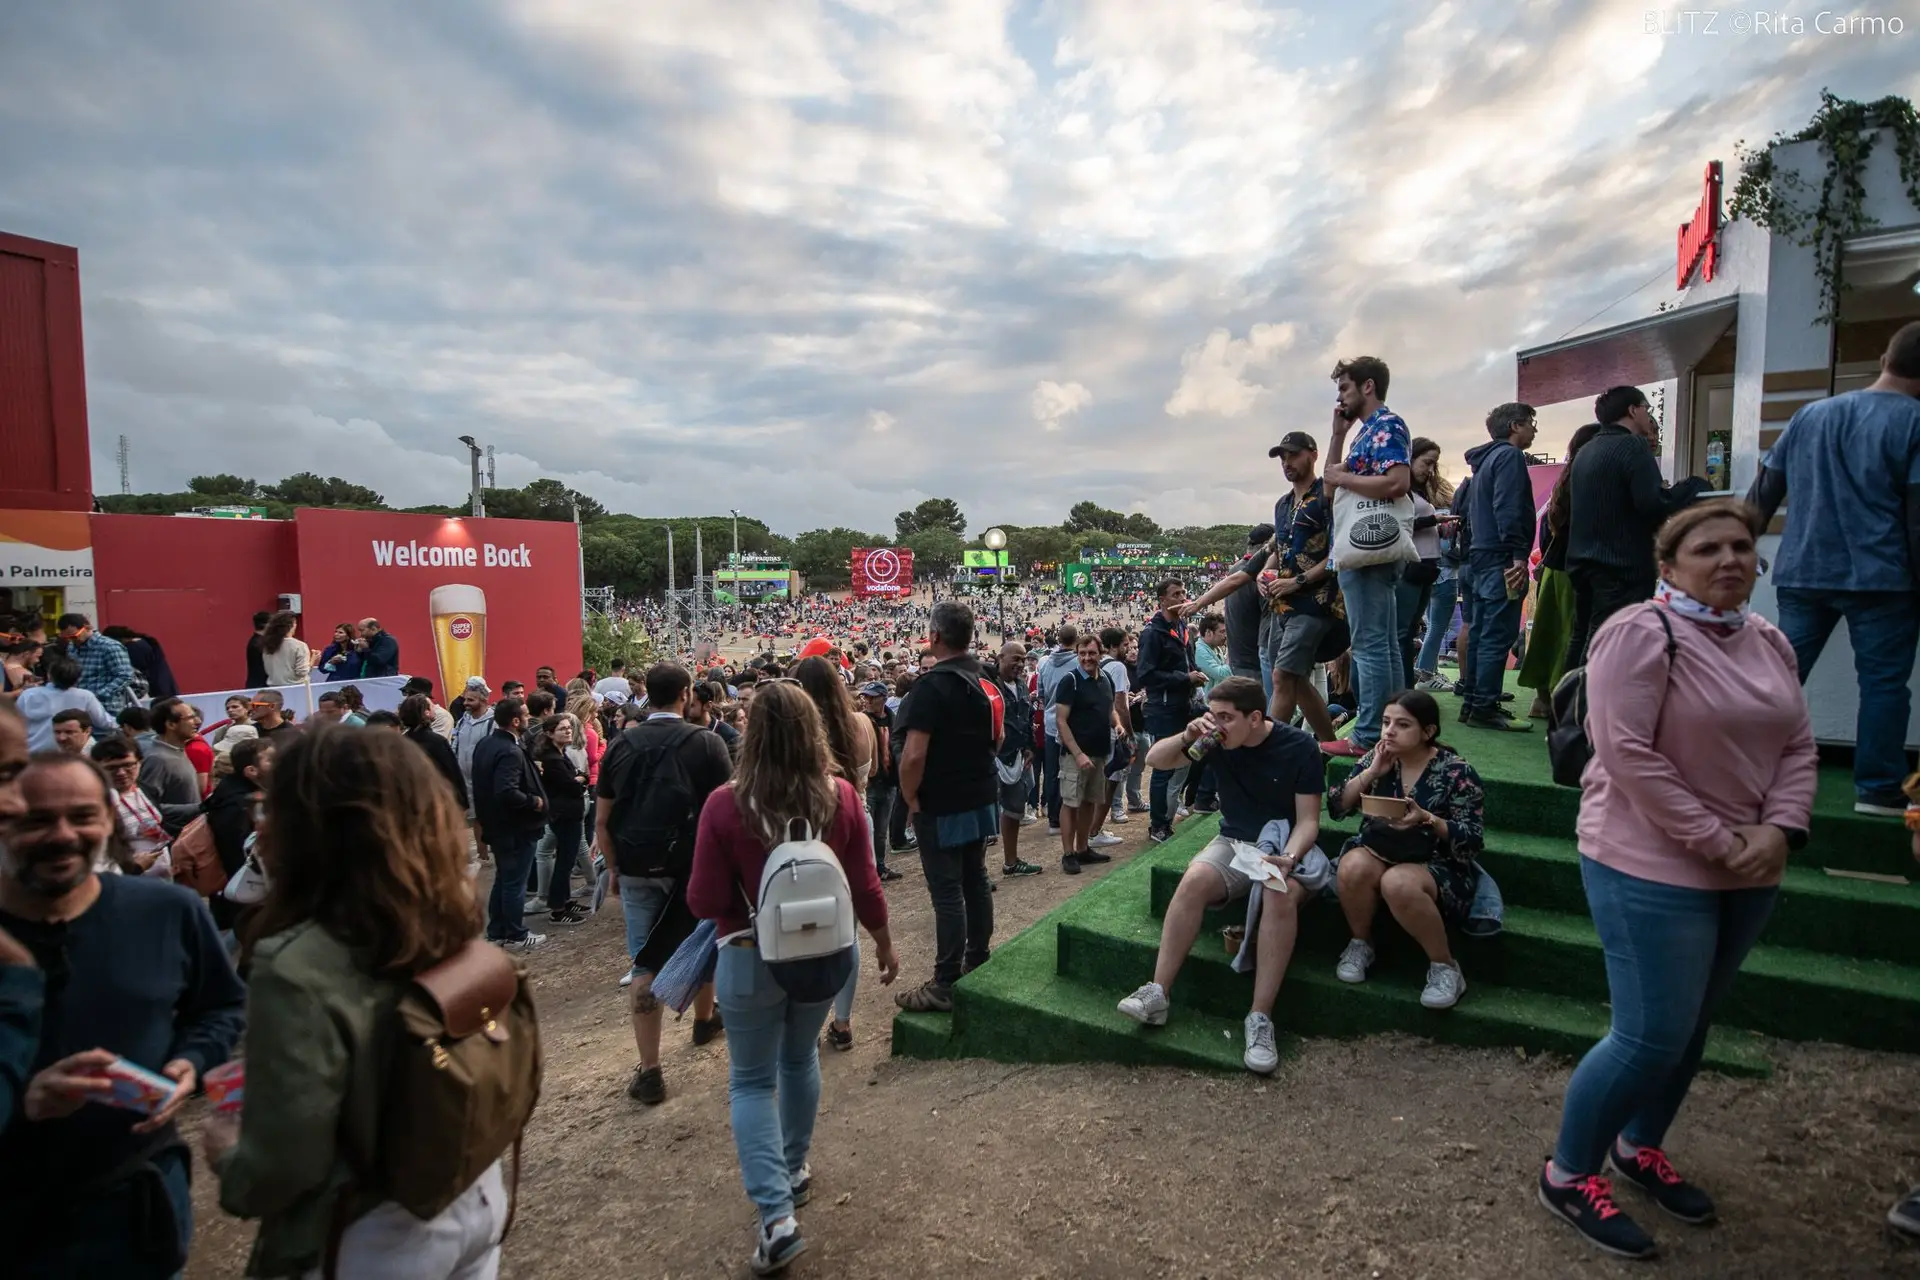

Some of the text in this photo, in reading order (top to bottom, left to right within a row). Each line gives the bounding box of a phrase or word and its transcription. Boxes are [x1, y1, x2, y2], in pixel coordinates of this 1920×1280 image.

[372, 539, 532, 568] Welcome Bock
[10, 565, 93, 578] Palmeira
[866, 583, 901, 592] vodafone
[452, 622, 471, 630] SUPER
